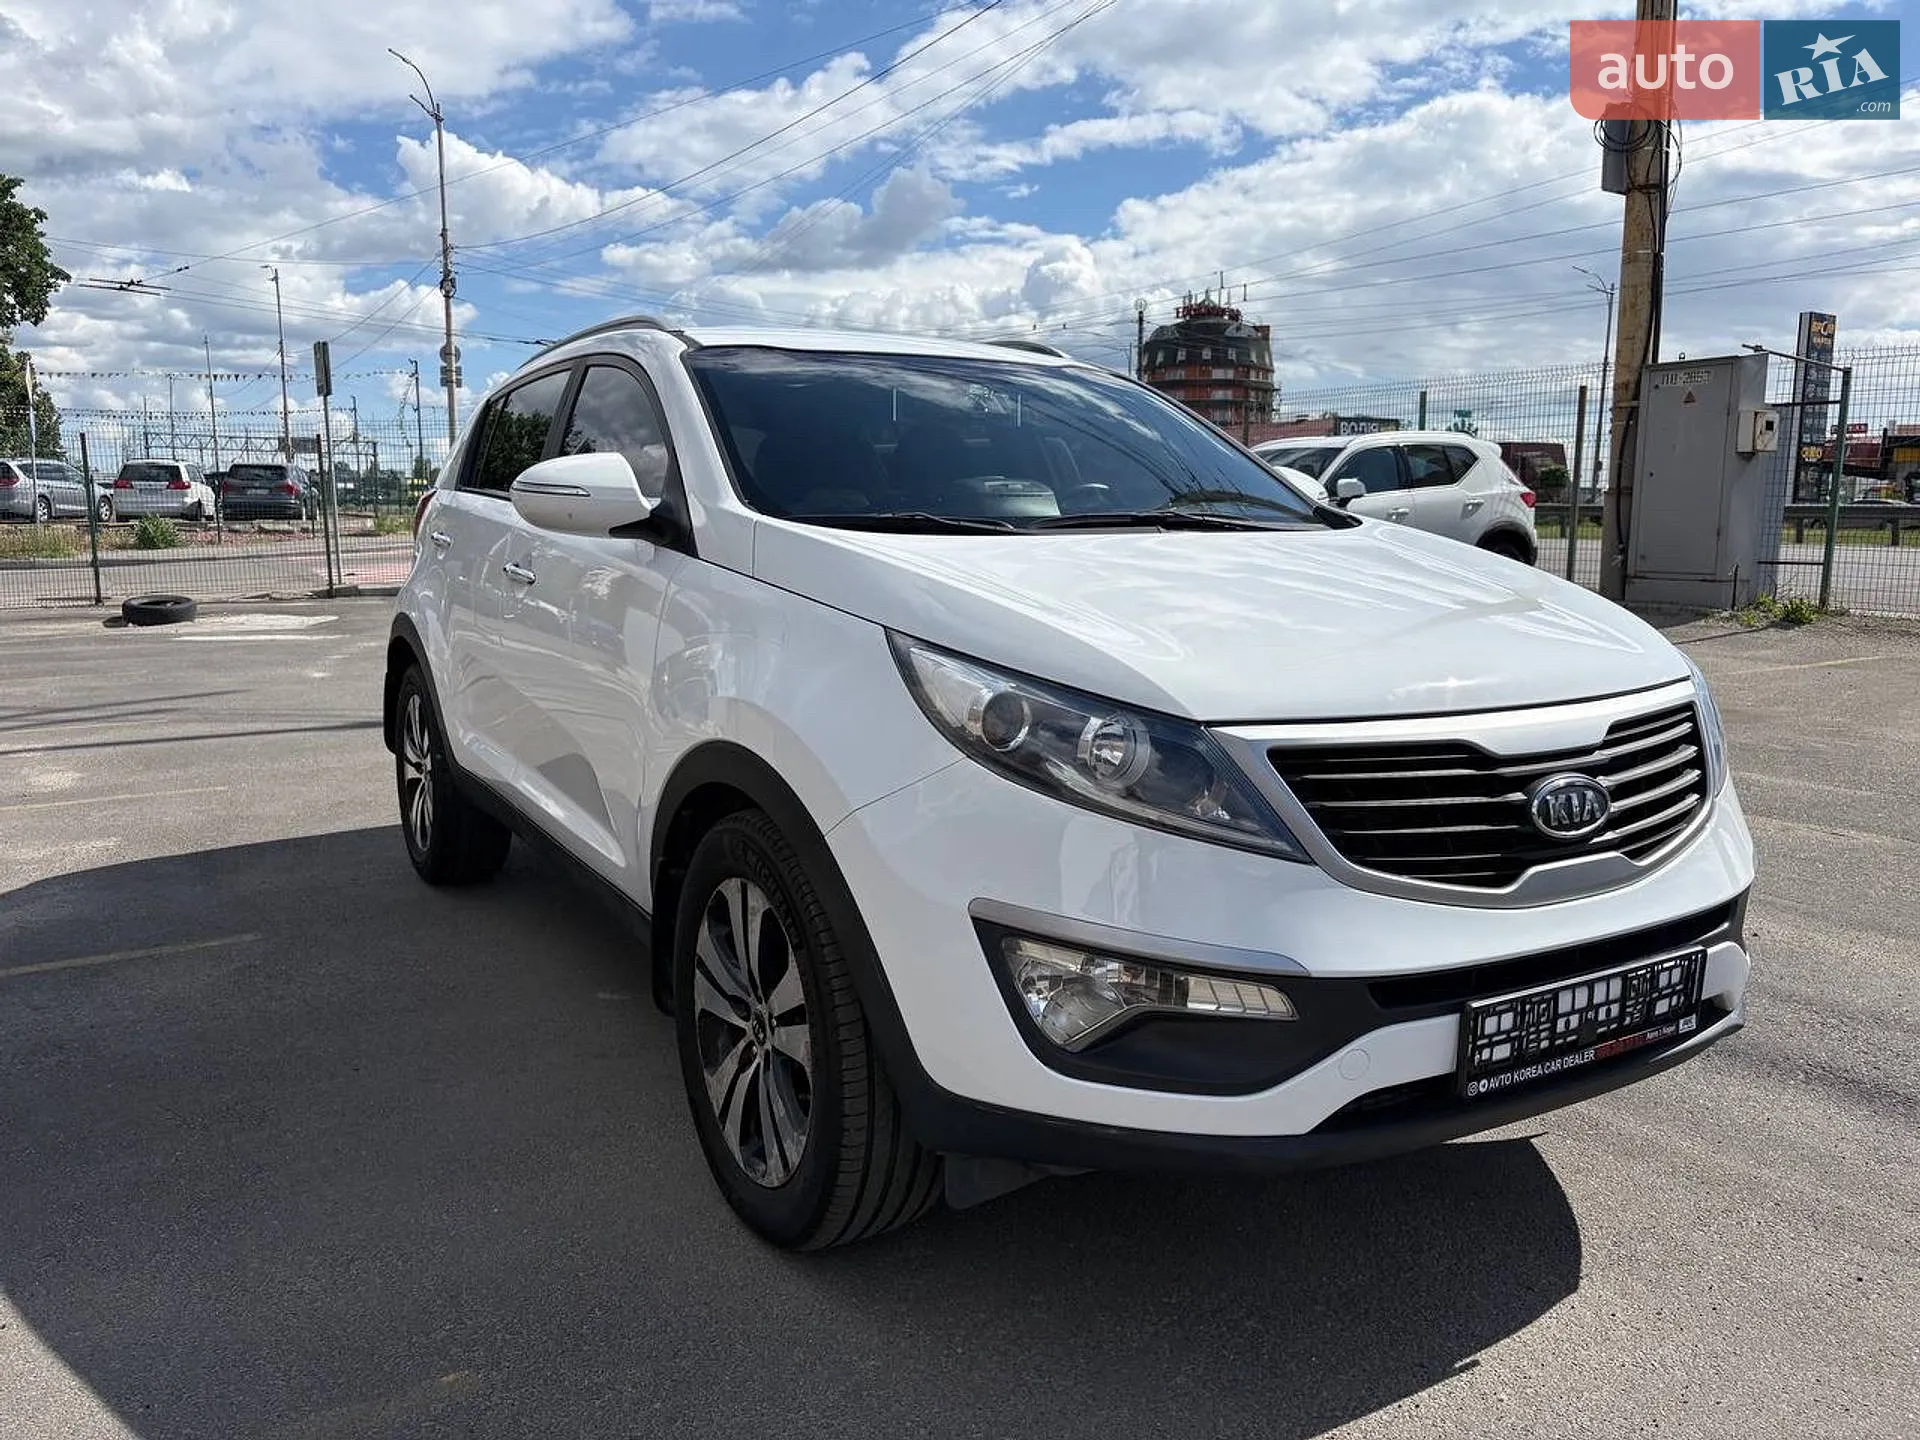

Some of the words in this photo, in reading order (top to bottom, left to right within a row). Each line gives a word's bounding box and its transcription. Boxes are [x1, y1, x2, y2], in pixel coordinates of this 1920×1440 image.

[1546, 790, 1601, 826] KIA
[1488, 1072, 1512, 1090] AVTO
[1513, 1064, 1543, 1083] KOREA
[1544, 1059, 1561, 1074] CAR
[1563, 1049, 1595, 1068] DEALER
